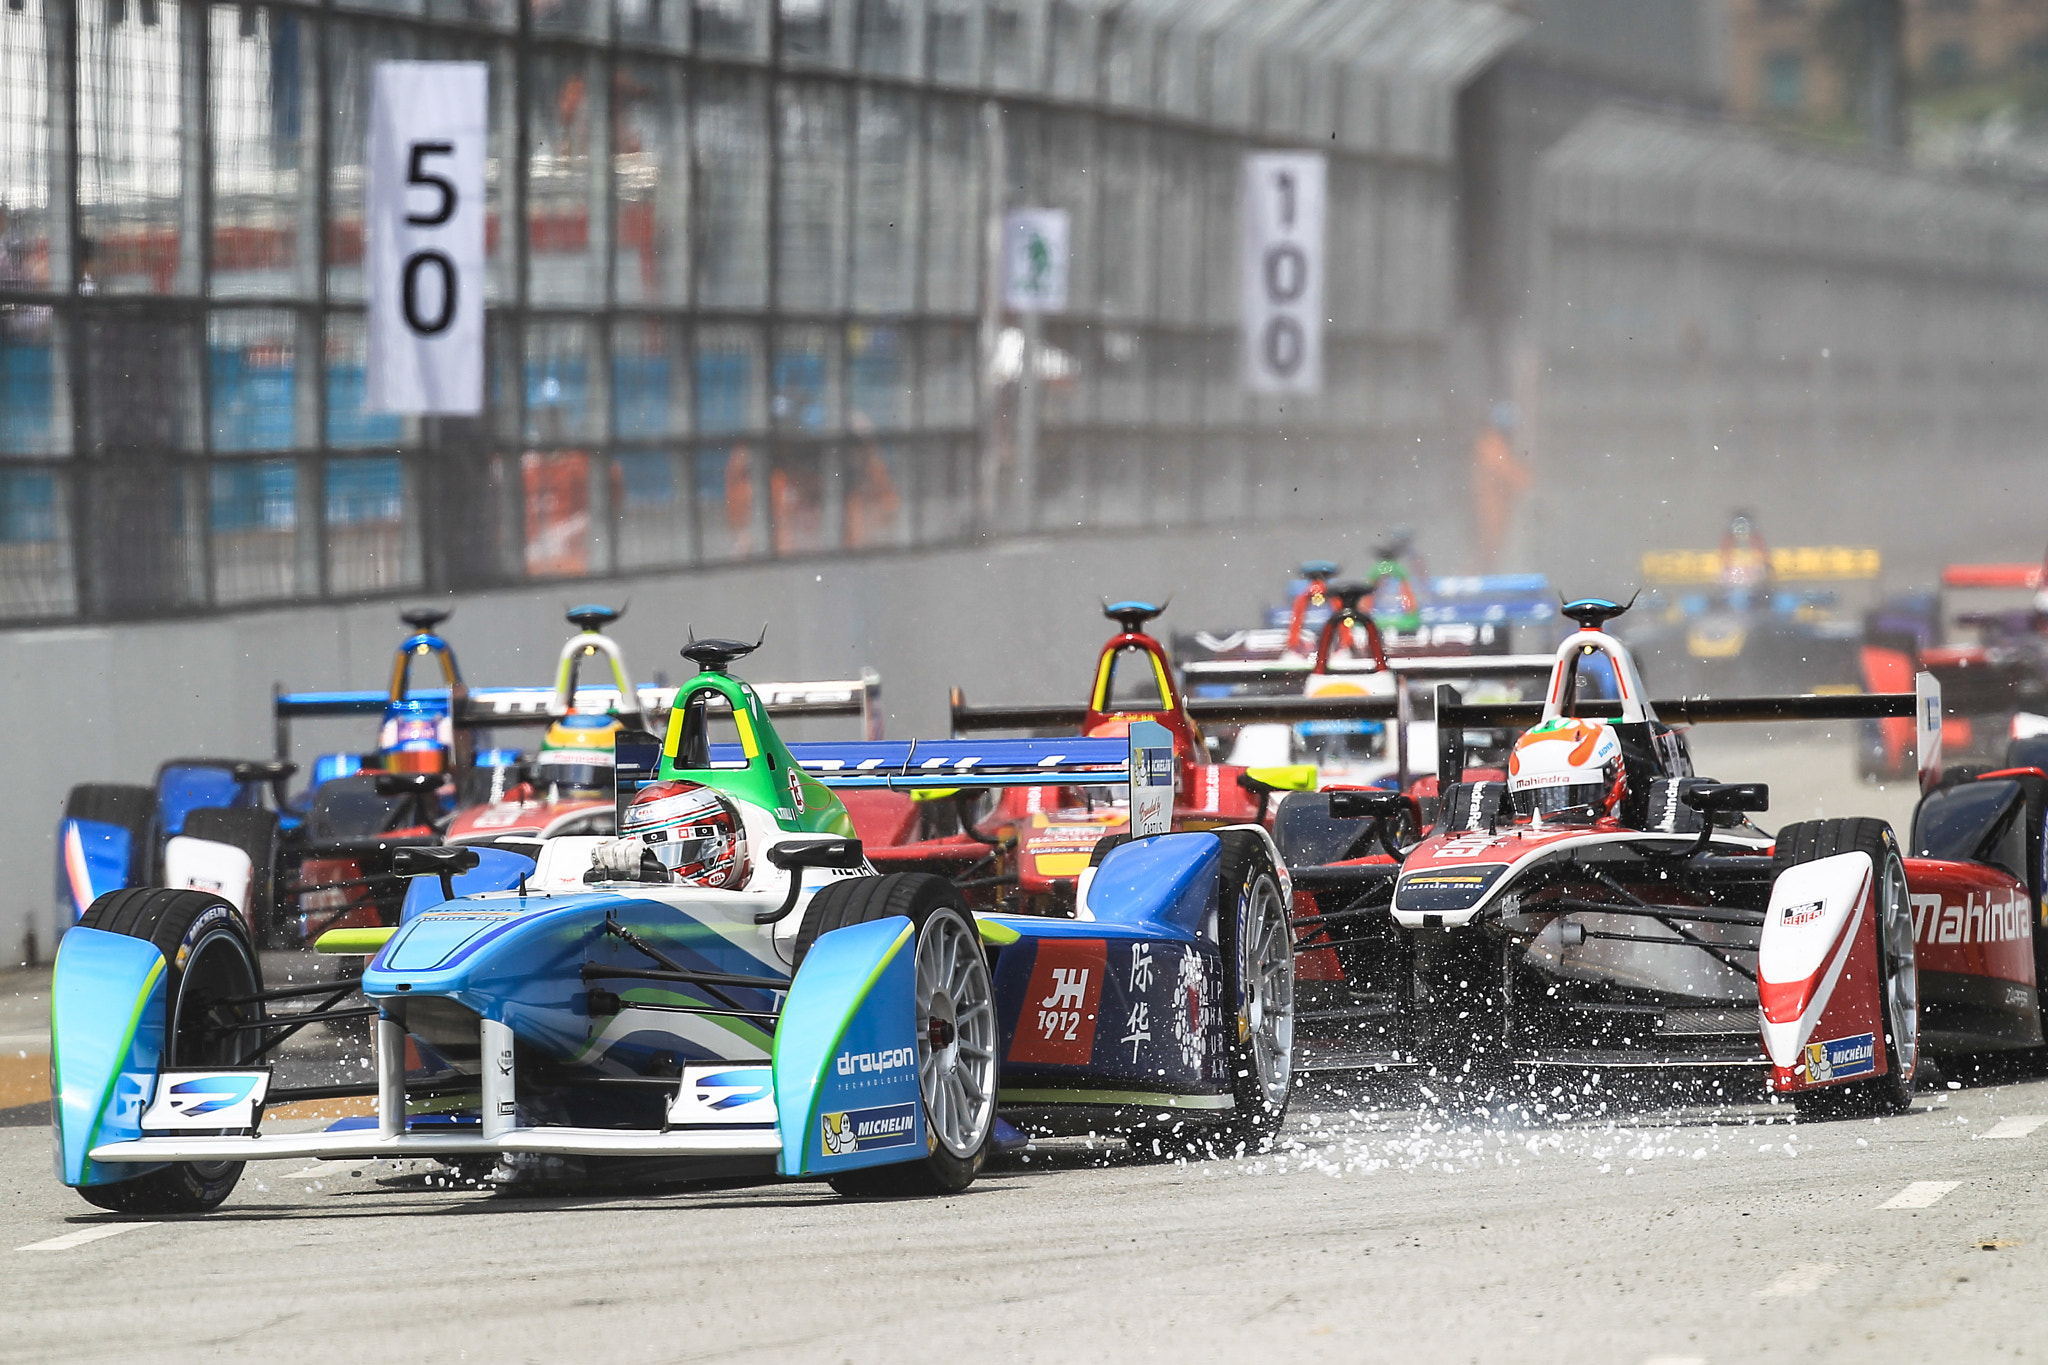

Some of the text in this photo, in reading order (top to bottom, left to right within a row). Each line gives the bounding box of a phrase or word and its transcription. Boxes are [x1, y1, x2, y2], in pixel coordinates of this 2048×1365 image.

[404, 140, 457, 337] 50
[1264, 170, 1308, 376] 100
[1516, 775, 1570, 788] Mahindra
[711, 874, 724, 883] BELL
[1910, 887, 2031, 944] Mahindra
[1042, 968, 1089, 1009] JH
[1120, 942, 1154, 1065] 际华
[1037, 1010, 1080, 1041] 1912
[837, 1047, 914, 1075] drayson
[1832, 1044, 1873, 1065] MICHELIN
[838, 1073, 915, 1091] TECHNOLOGIES
[857, 1115, 914, 1137] MICHELIN
